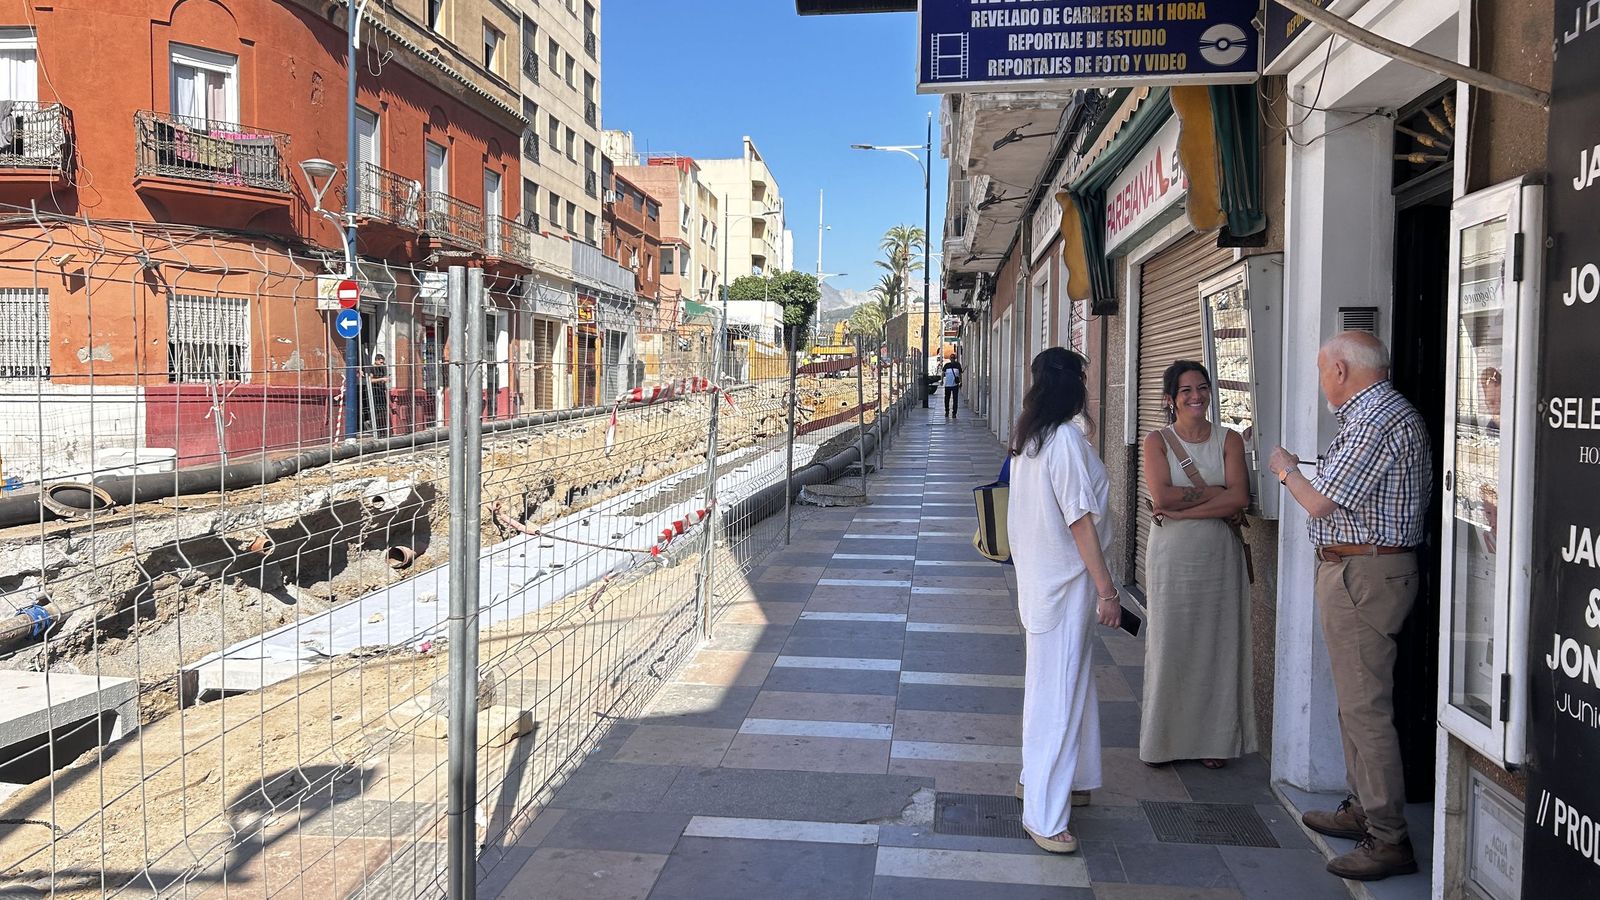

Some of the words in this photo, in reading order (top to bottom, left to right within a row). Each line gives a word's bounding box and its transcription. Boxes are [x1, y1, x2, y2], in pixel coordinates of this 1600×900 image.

[971, 8, 1040, 28] REVELADO
[1042, 8, 1061, 25] DE
[1063, 5, 1134, 25] CARRETES
[1136, 4, 1154, 22] EN
[1156, 4, 1164, 21] 1
[1166, 2, 1207, 20] HORA
[1008, 31, 1083, 51] REPORTAJE
[1086, 31, 1104, 49] DE
[1106, 28, 1167, 48] ESTUDIO
[988, 56, 1072, 77] REPORTAJES
[1074, 56, 1092, 74] DE
[1095, 54, 1130, 73] FOTO
[1132, 54, 1142, 72] Y
[1144, 52, 1187, 72] VIDEO
[1563, 263, 1600, 307] JO
[1579, 446, 1600, 464] HO
[1562, 524, 1600, 568] JA
